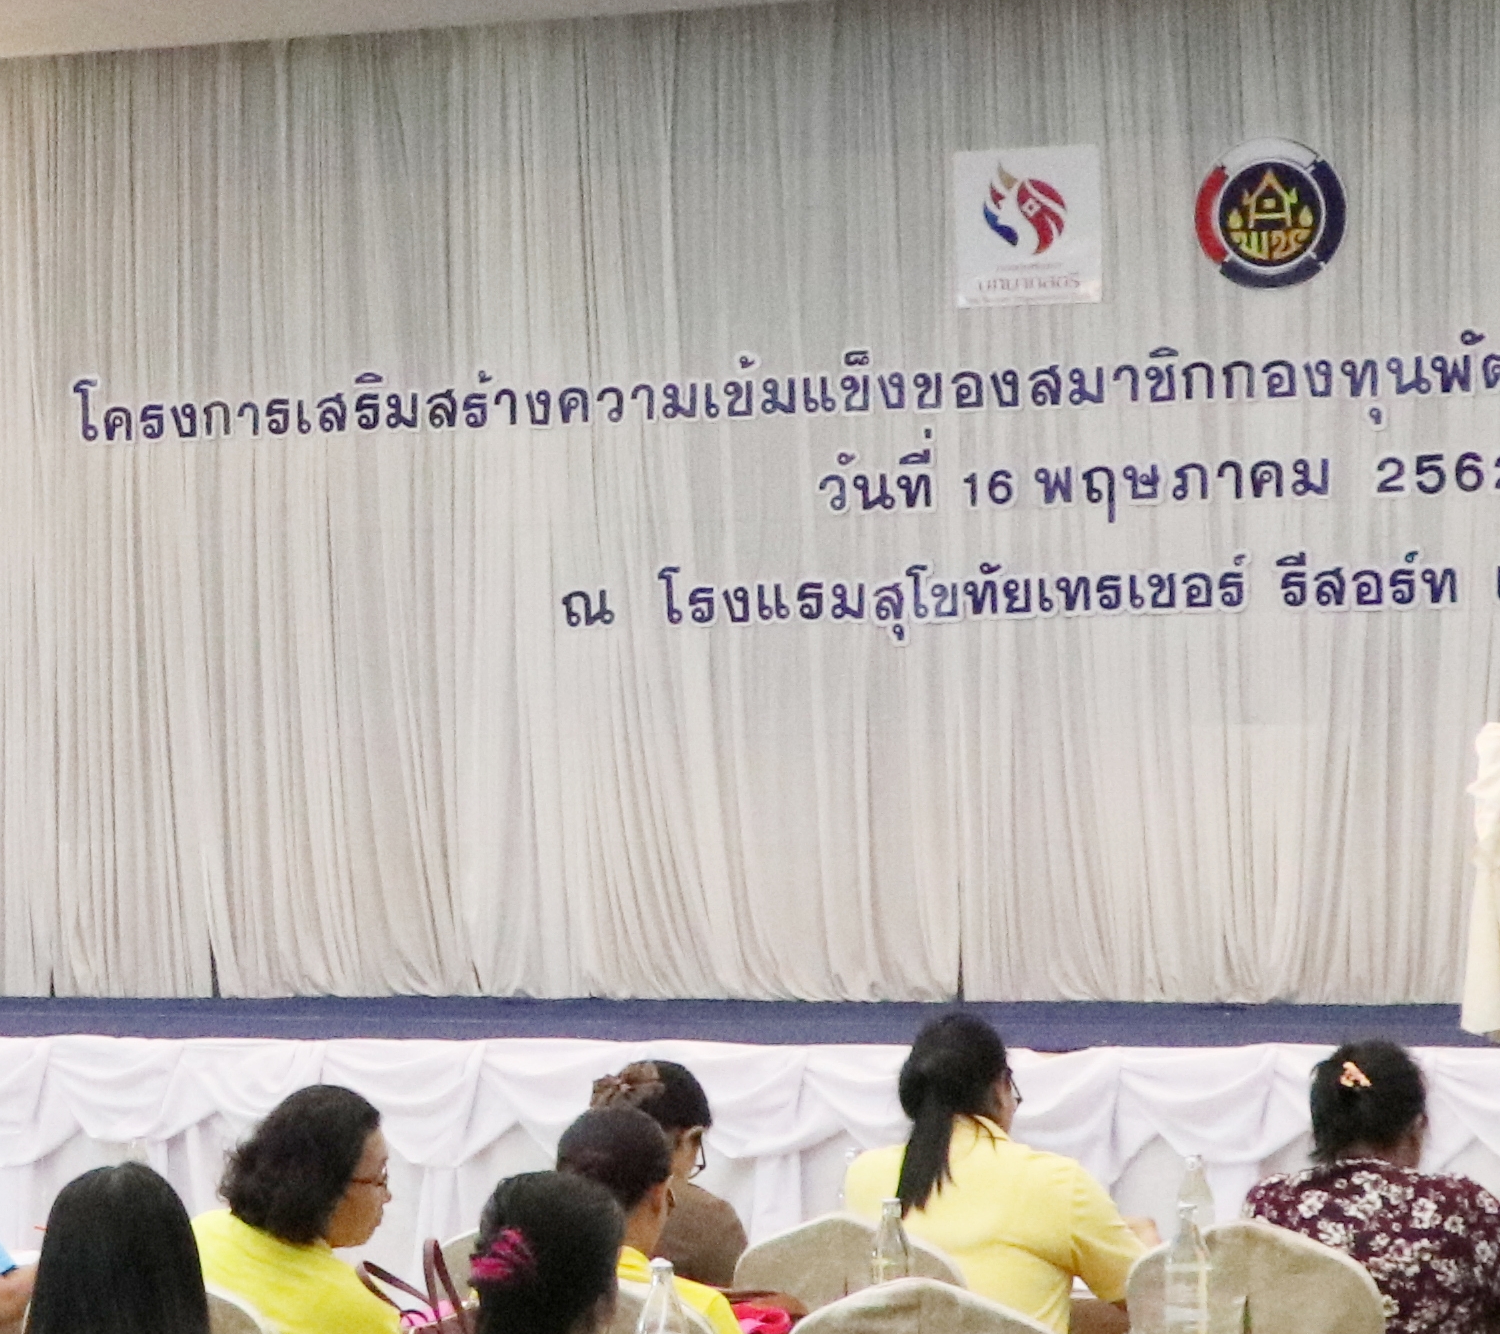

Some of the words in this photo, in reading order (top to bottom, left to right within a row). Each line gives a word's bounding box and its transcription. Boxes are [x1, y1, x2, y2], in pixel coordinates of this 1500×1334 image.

[817, 427, 934, 513] วันที่
[961, 468, 1015, 507] 16
[1032, 455, 1331, 525] พฤษภาคม
[560, 588, 617, 629] ณ
[655, 552, 1248, 643] โรงแรมสุโขทัยเทรเชอร์
[1273, 549, 1459, 609] รีสอร์ท
